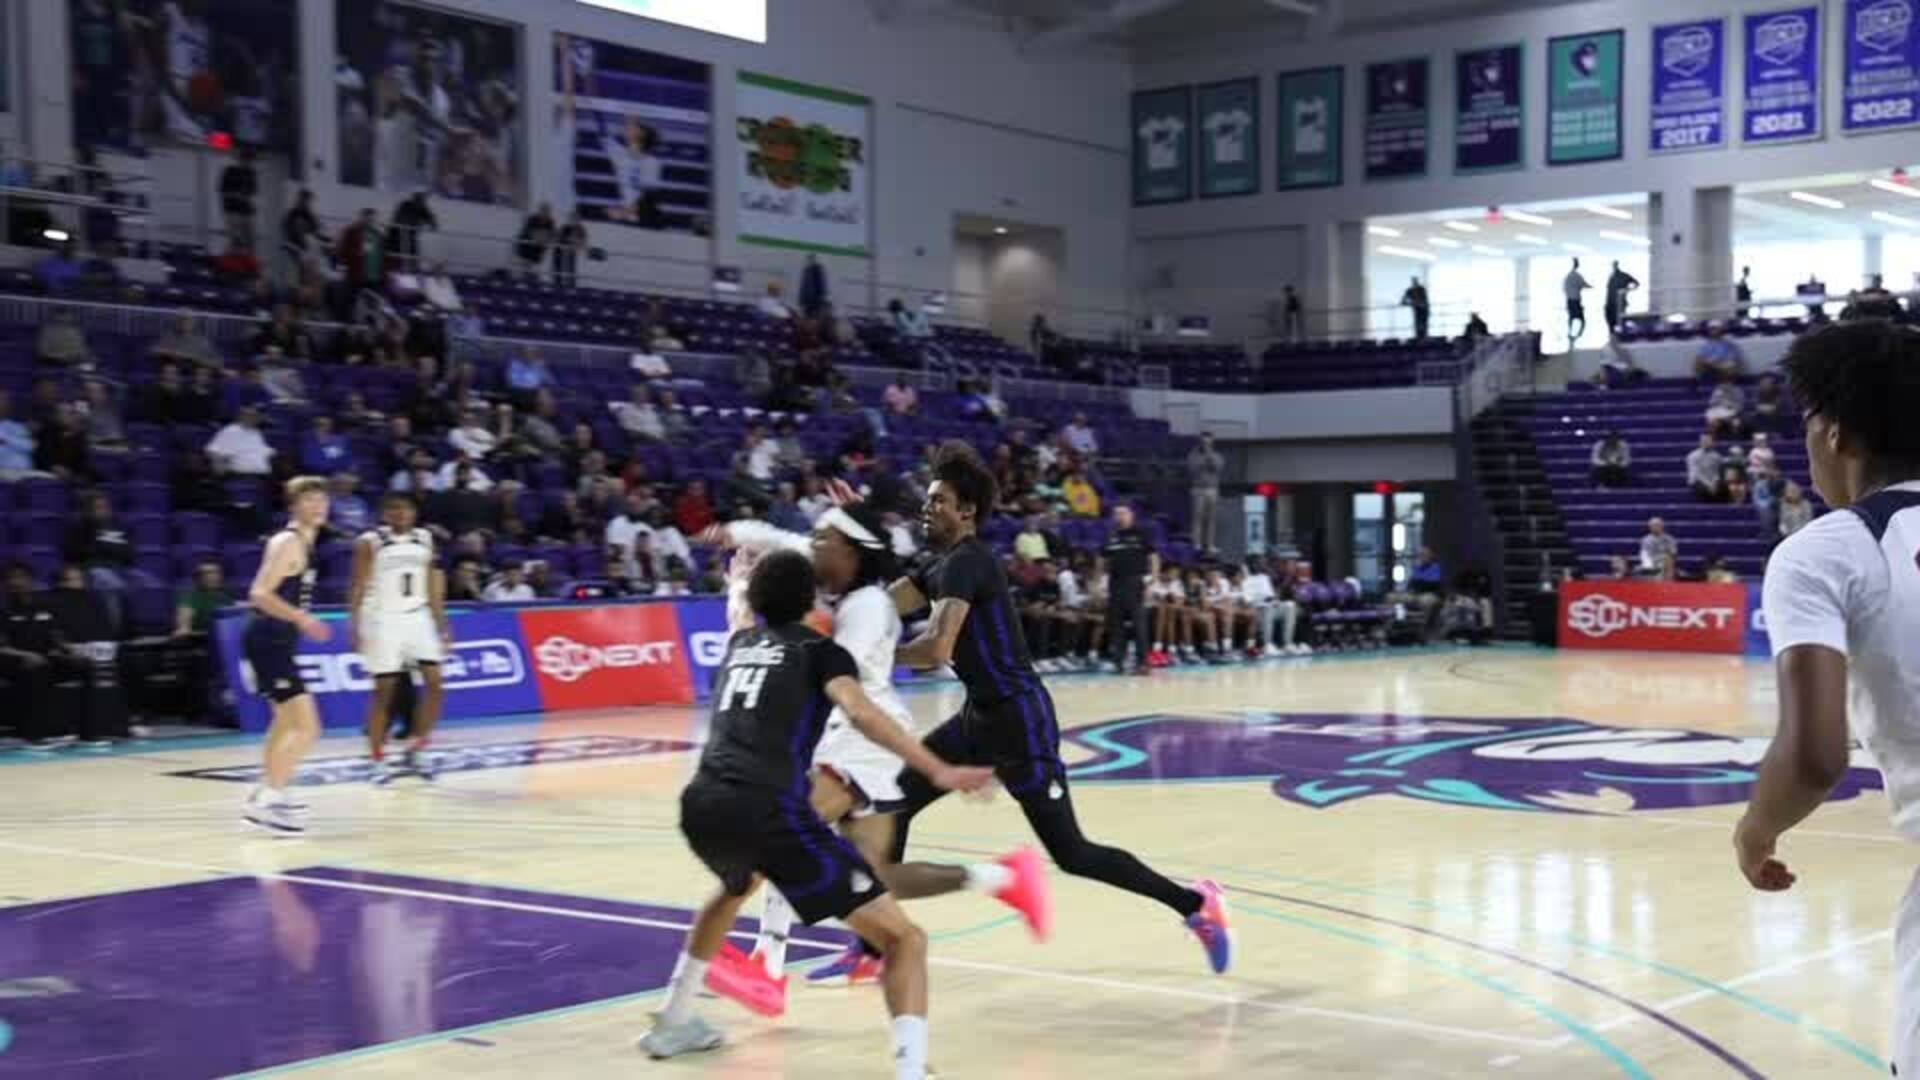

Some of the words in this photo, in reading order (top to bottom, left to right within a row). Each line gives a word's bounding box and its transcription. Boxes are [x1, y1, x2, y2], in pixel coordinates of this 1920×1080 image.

[1851, 98, 1913, 122] 2022
[1751, 111, 1806, 134] 2021
[1661, 125, 1711, 146] 2017
[1630, 606, 1734, 629] NEXT
[599, 641, 676, 667] NEXT
[719, 667, 768, 711] 14
